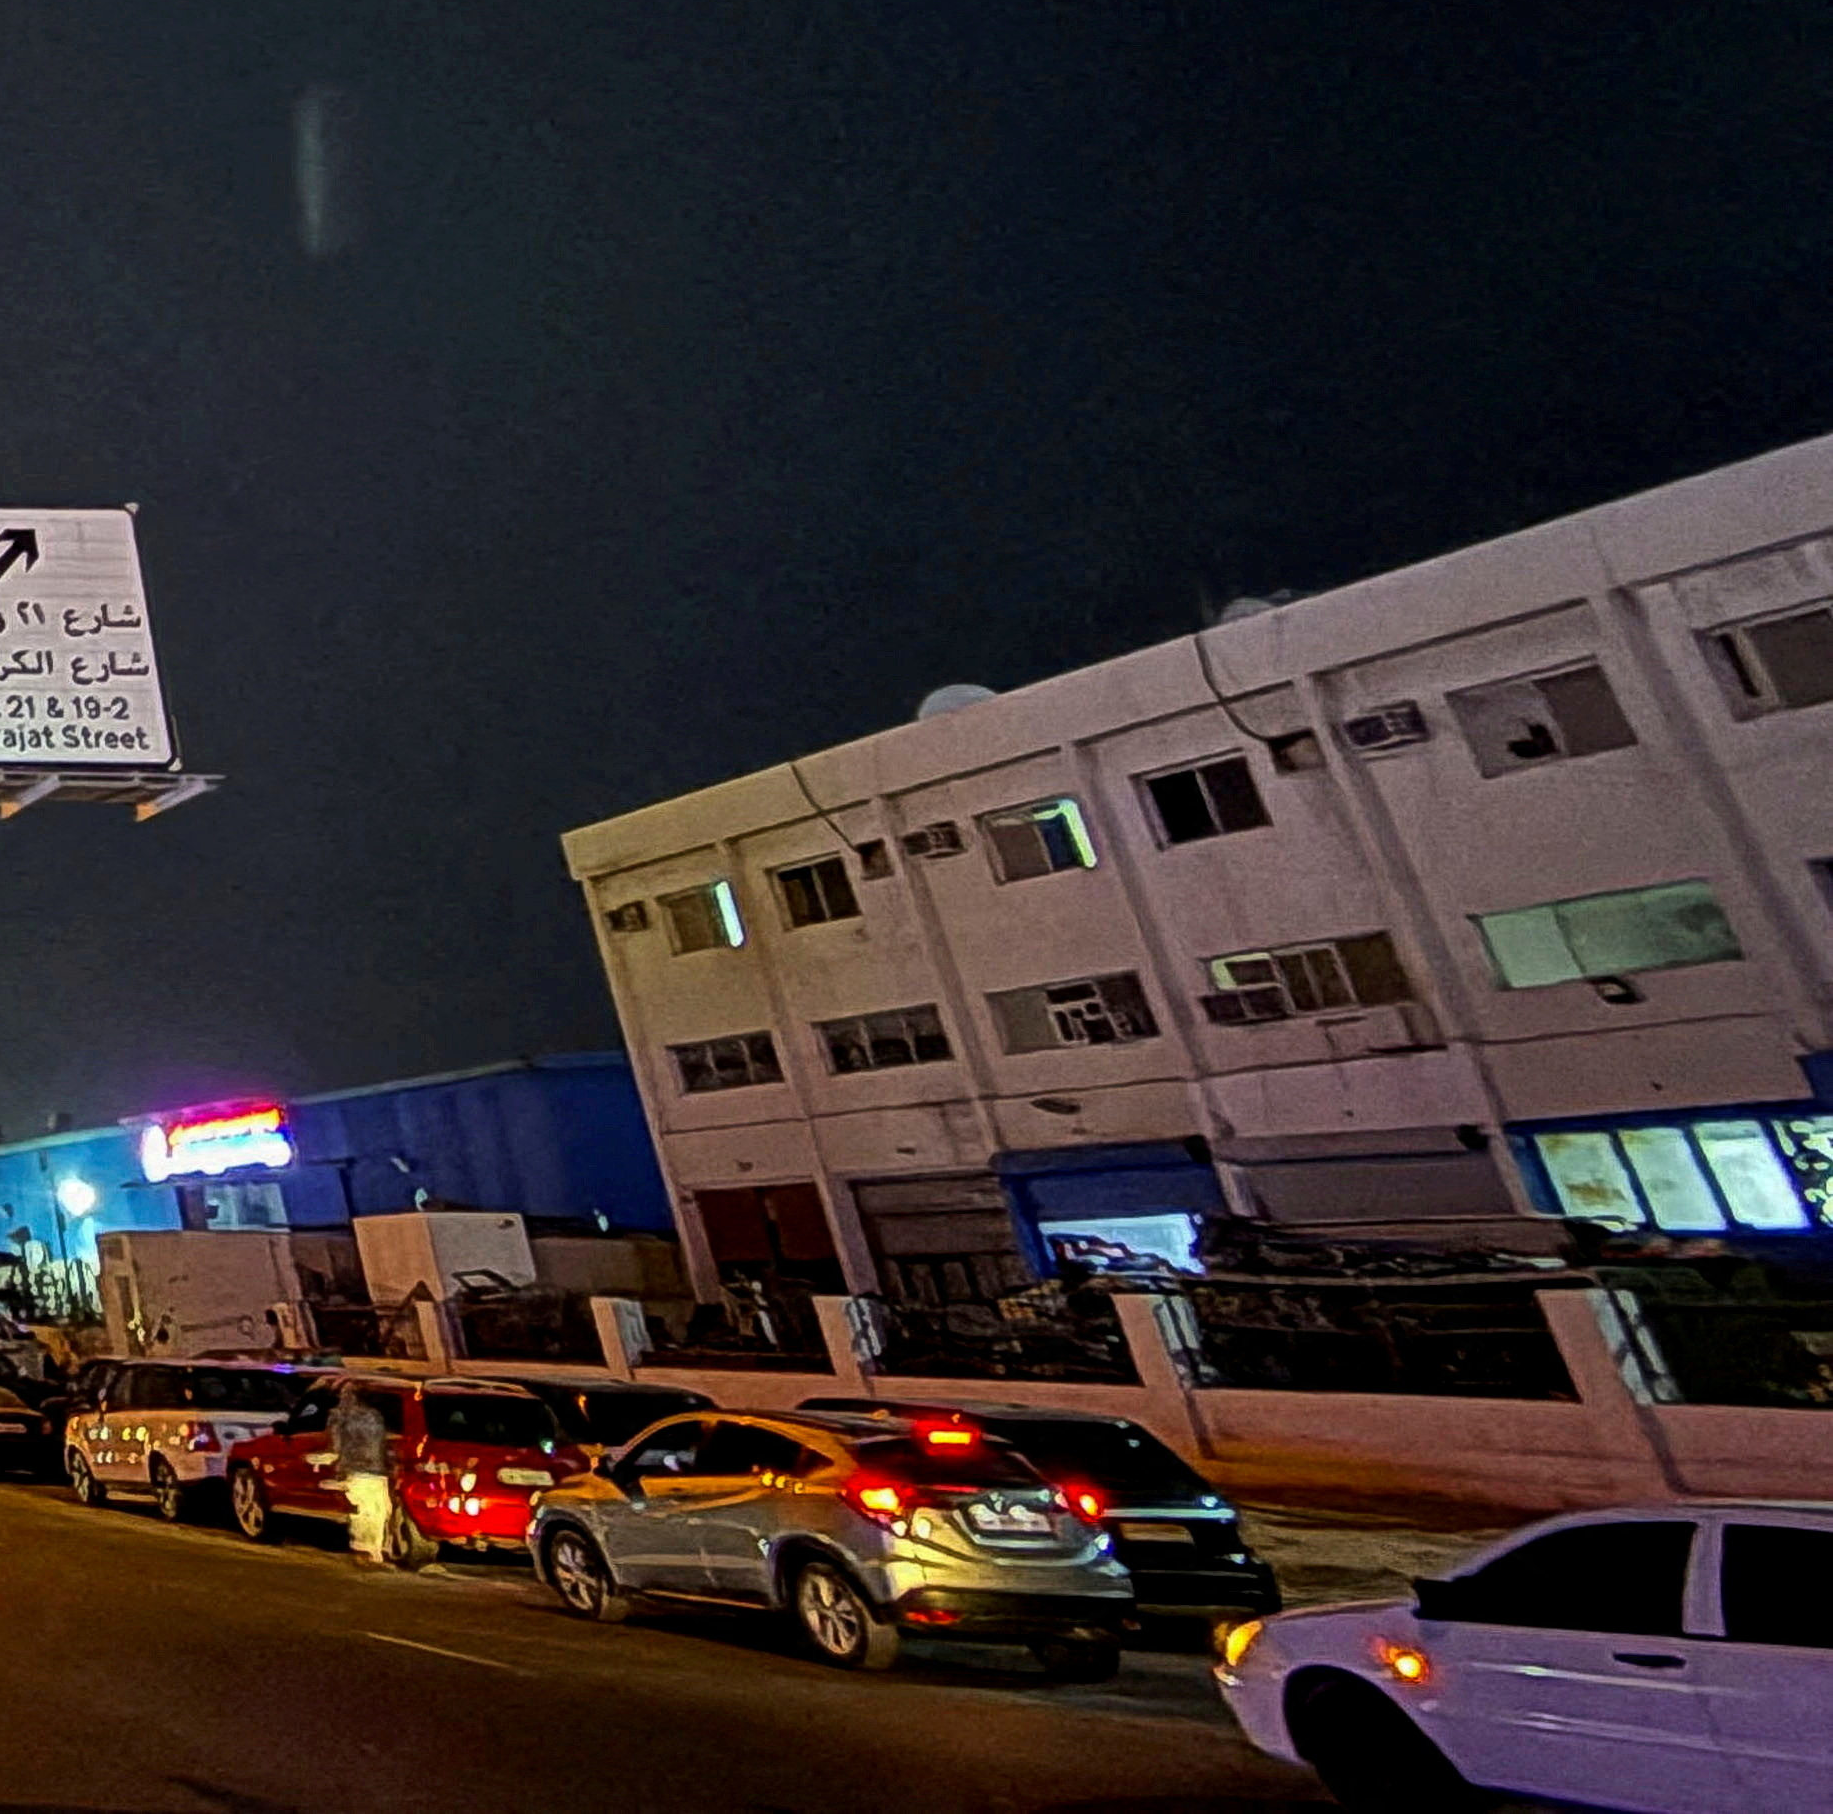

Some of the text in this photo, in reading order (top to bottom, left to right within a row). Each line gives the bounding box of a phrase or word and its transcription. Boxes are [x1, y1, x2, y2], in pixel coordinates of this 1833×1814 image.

[62, 602, 142, 636] شارع
[71, 651, 150, 685] شارع
[6, 694, 36, 719] 21
[46, 695, 64, 719] &
[72, 695, 131, 721] 19-2
[62, 723, 151, 751] Street
